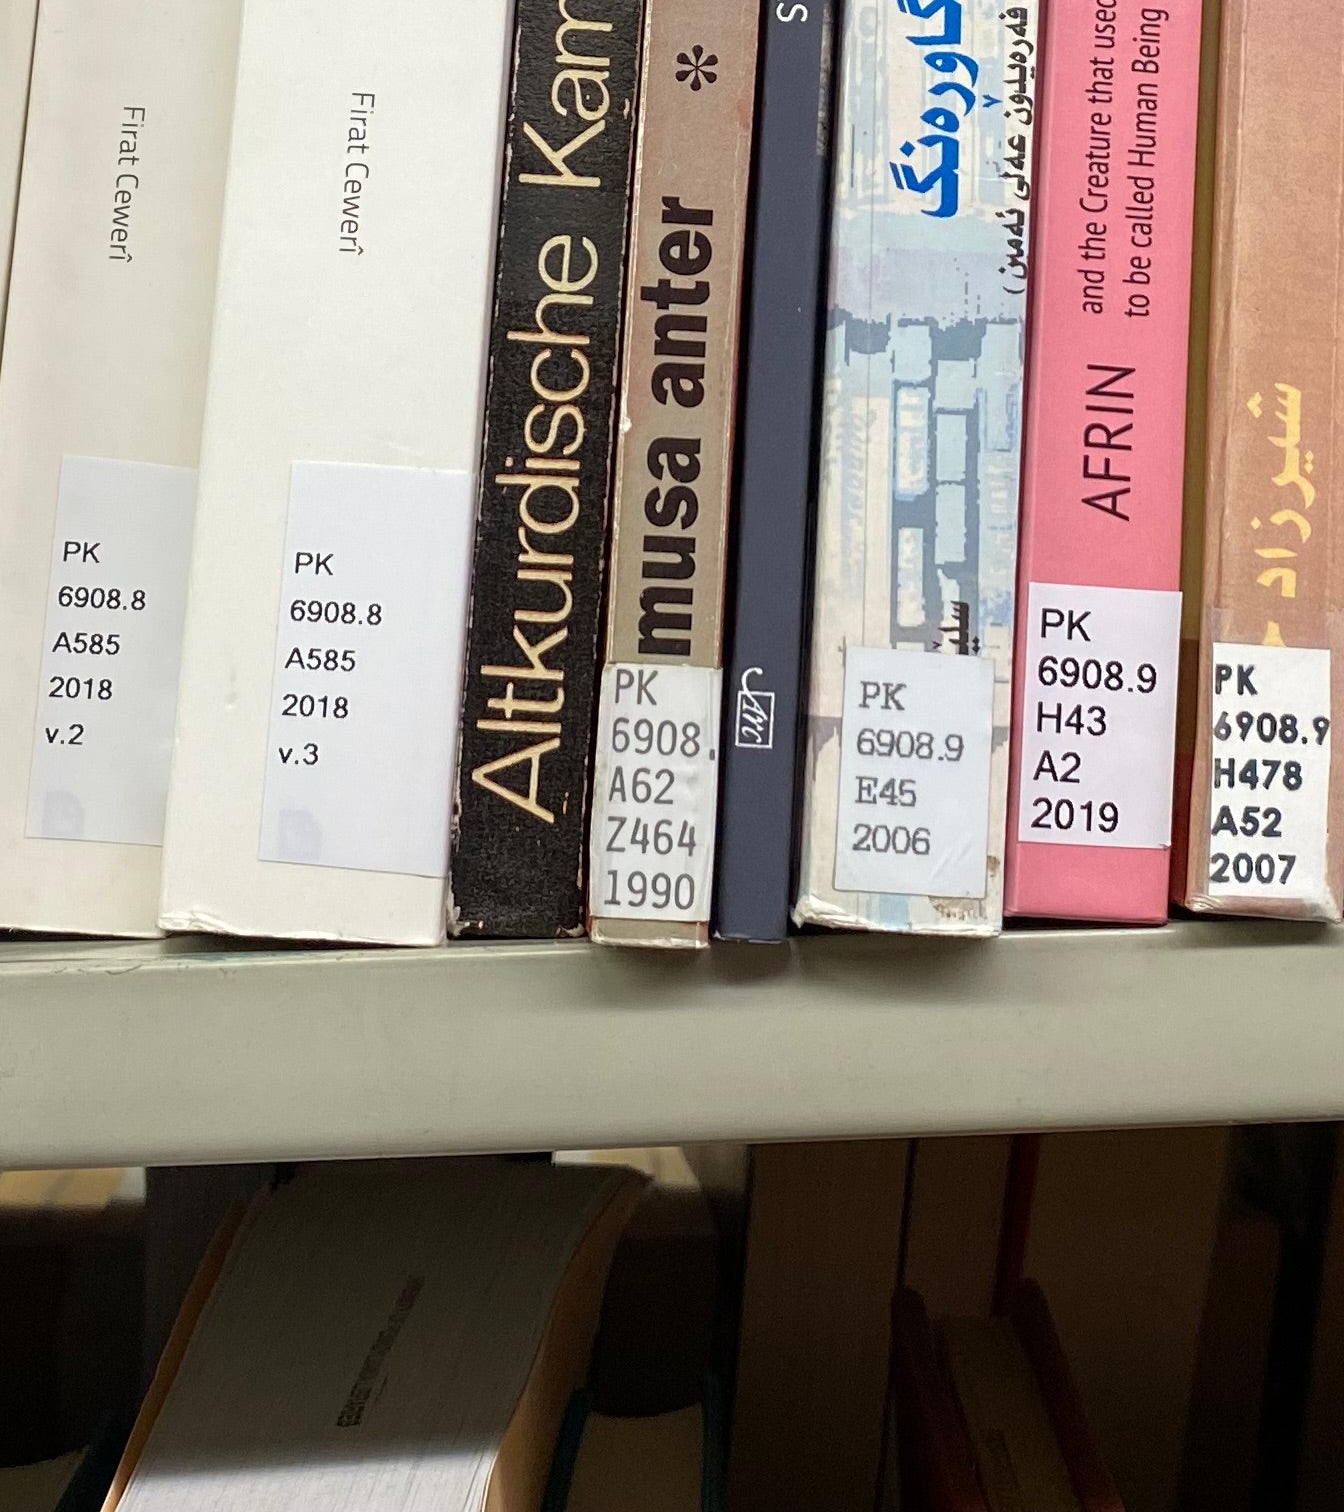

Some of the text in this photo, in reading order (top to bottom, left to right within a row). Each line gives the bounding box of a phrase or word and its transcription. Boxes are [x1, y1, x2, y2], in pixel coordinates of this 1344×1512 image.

[1086, 57, 1115, 104] that
[338, 92, 375, 256] Firat Cewerî
[1080, 112, 1113, 213] Creature
[1122, 8, 1170, 318] to be called Human Being
[108, 105, 145, 263] Firat Cewerî
[1078, 222, 1107, 261] the
[640, 196, 714, 407] anter
[1077, 269, 1105, 315] and
[1081, 363, 1136, 521] AFRIN
[472, 234, 598, 823] Altkurdische
[62, 542, 100, 563] PK
[638, 437, 701, 656] musa
[294, 552, 334, 576] PK
[57, 586, 146, 610] 6908.8
[289, 600, 382, 626] 6908.8
[1040, 608, 1091, 642] PK
[52, 632, 120, 655] A585
[285, 648, 356, 672] A585
[48, 676, 112, 700] 2018
[615, 670, 657, 705] PK
[1037, 656, 1157, 694] 6908.9
[1215, 665, 1257, 696] PK
[281, 695, 348, 719] 2018
[859, 682, 906, 711] PK
[45, 724, 84, 745] v.2
[1036, 703, 1106, 737] H43
[1214, 715, 1330, 746] 6908.9
[278, 744, 319, 766] v.3
[856, 732, 964, 762] 6908.9
[1033, 753, 1081, 783] A2
[1214, 758, 1302, 790] H478
[608, 767, 674, 804] A62
[855, 778, 917, 808] E45
[1030, 797, 1118, 833] 2019
[1212, 806, 1282, 839] A52
[605, 816, 696, 856] Z464
[852, 825, 931, 856] 2006
[1209, 854, 1296, 885] 2007
[603, 868, 696, 909] 1990
